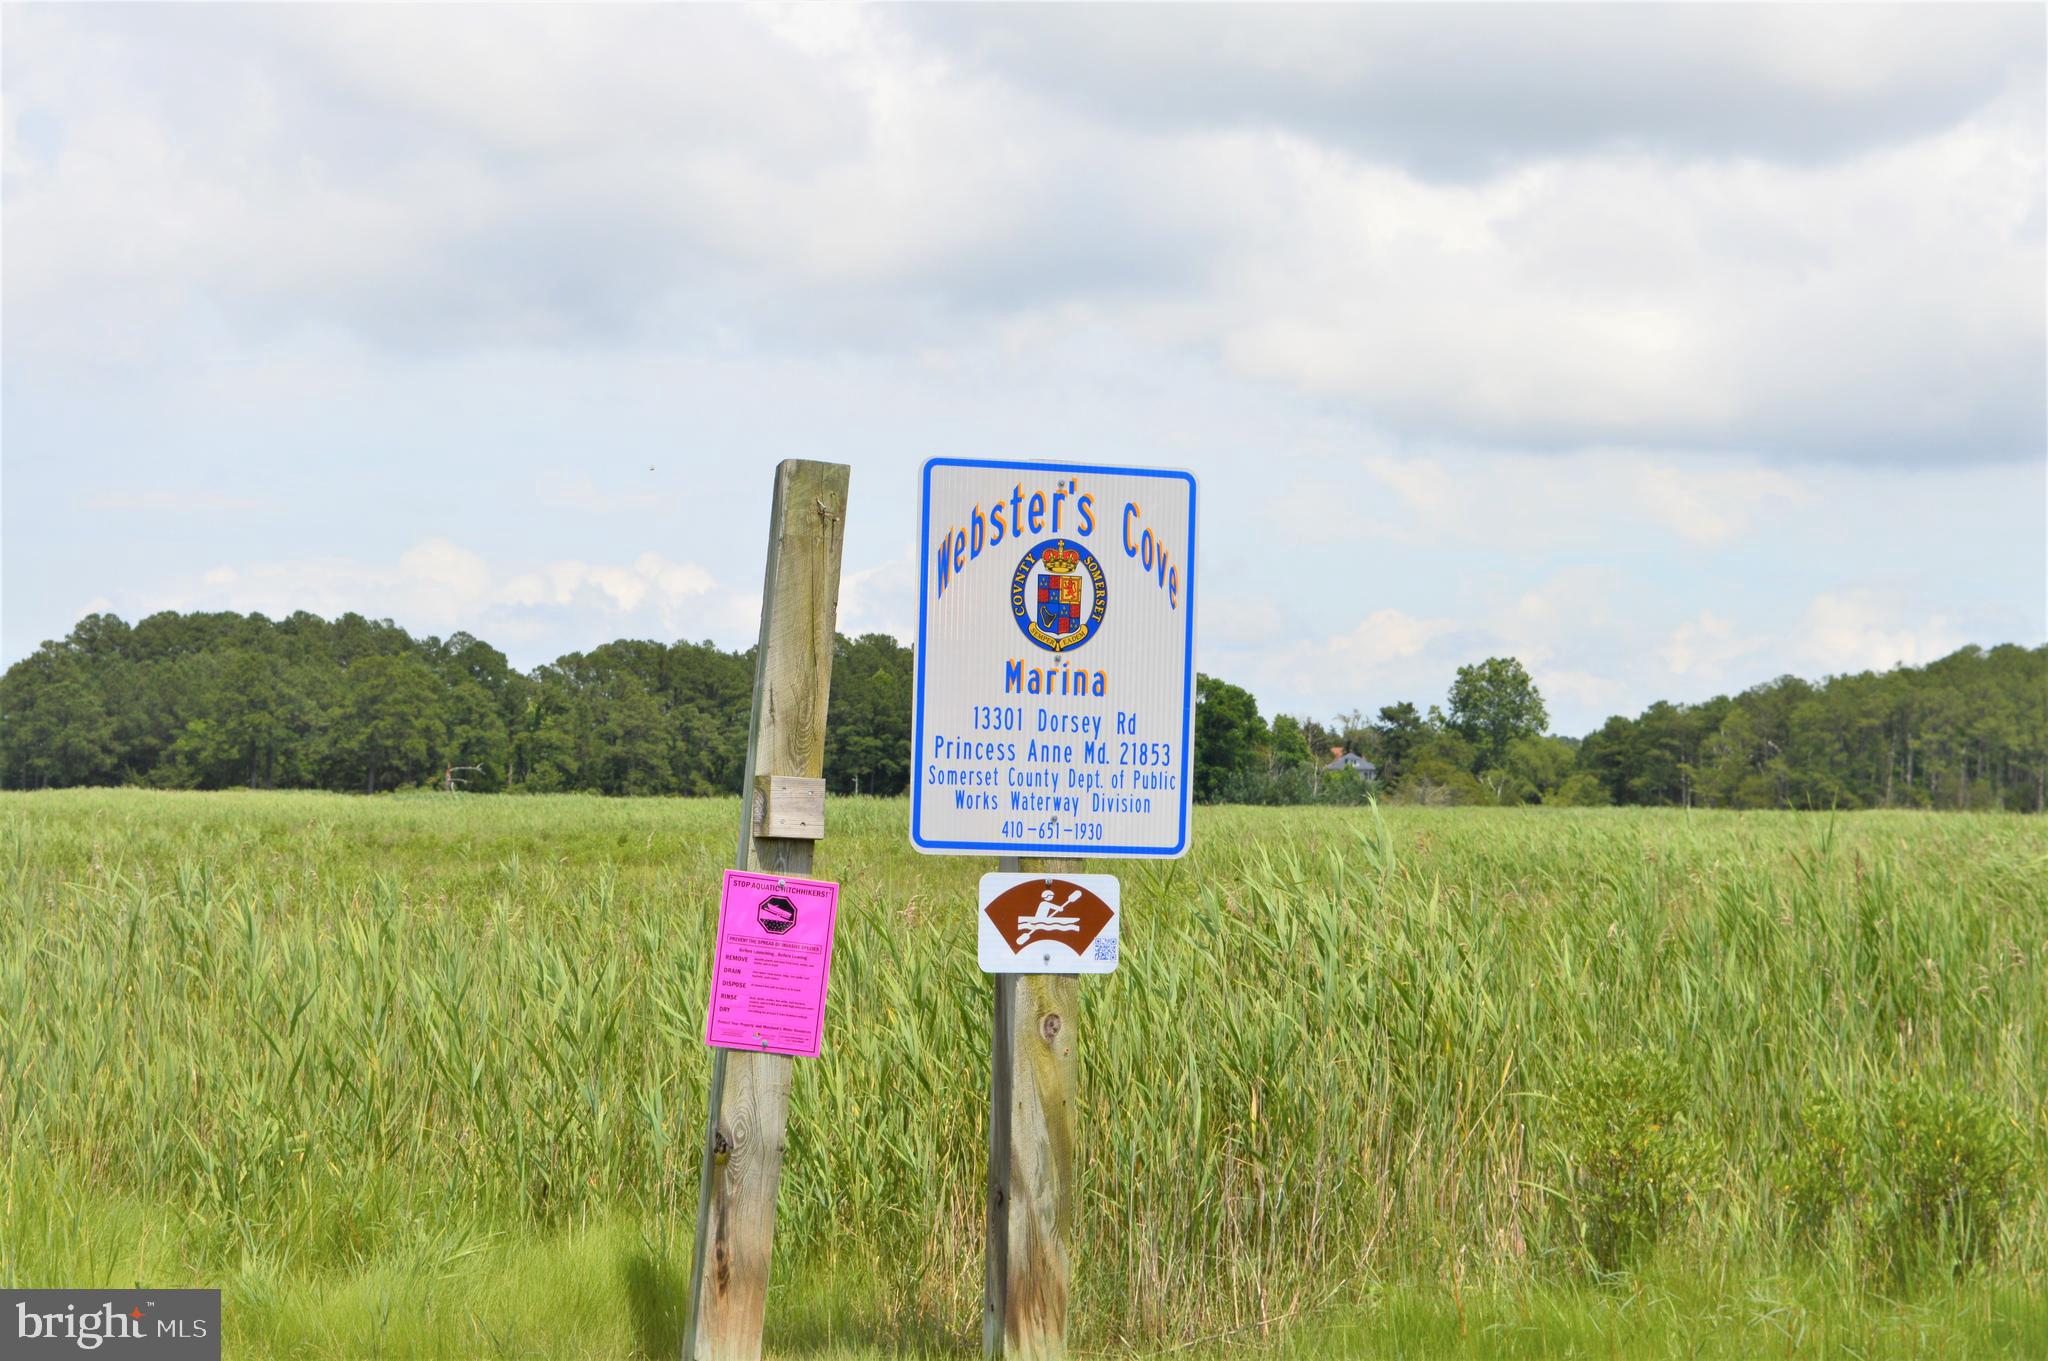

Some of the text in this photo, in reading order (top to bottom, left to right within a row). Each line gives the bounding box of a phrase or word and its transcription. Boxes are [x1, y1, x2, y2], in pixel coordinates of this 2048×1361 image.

[937, 477, 1179, 610] Webster's Cove
[1083, 555, 1106, 623] SOMERSET
[1031, 627, 1086, 646] SEMPER EADEM
[1005, 658, 1108, 697] Marina
[973, 706, 1136, 740] 13301 Dorsey Rd
[934, 735, 1171, 766] Princess Anne Md. 21853
[928, 765, 1176, 792] Somerset County Dept. of Public
[955, 789, 1151, 817] Works Waterway Division
[1001, 820, 1103, 841] 410-651-1930
[733, 879, 751, 887] STOP
[752, 882, 780, 892] AQUATIC
[723, 967, 741, 975] DRAIN
[725, 954, 748, 962] REMOVE
[722, 980, 746, 988] DISPOSE
